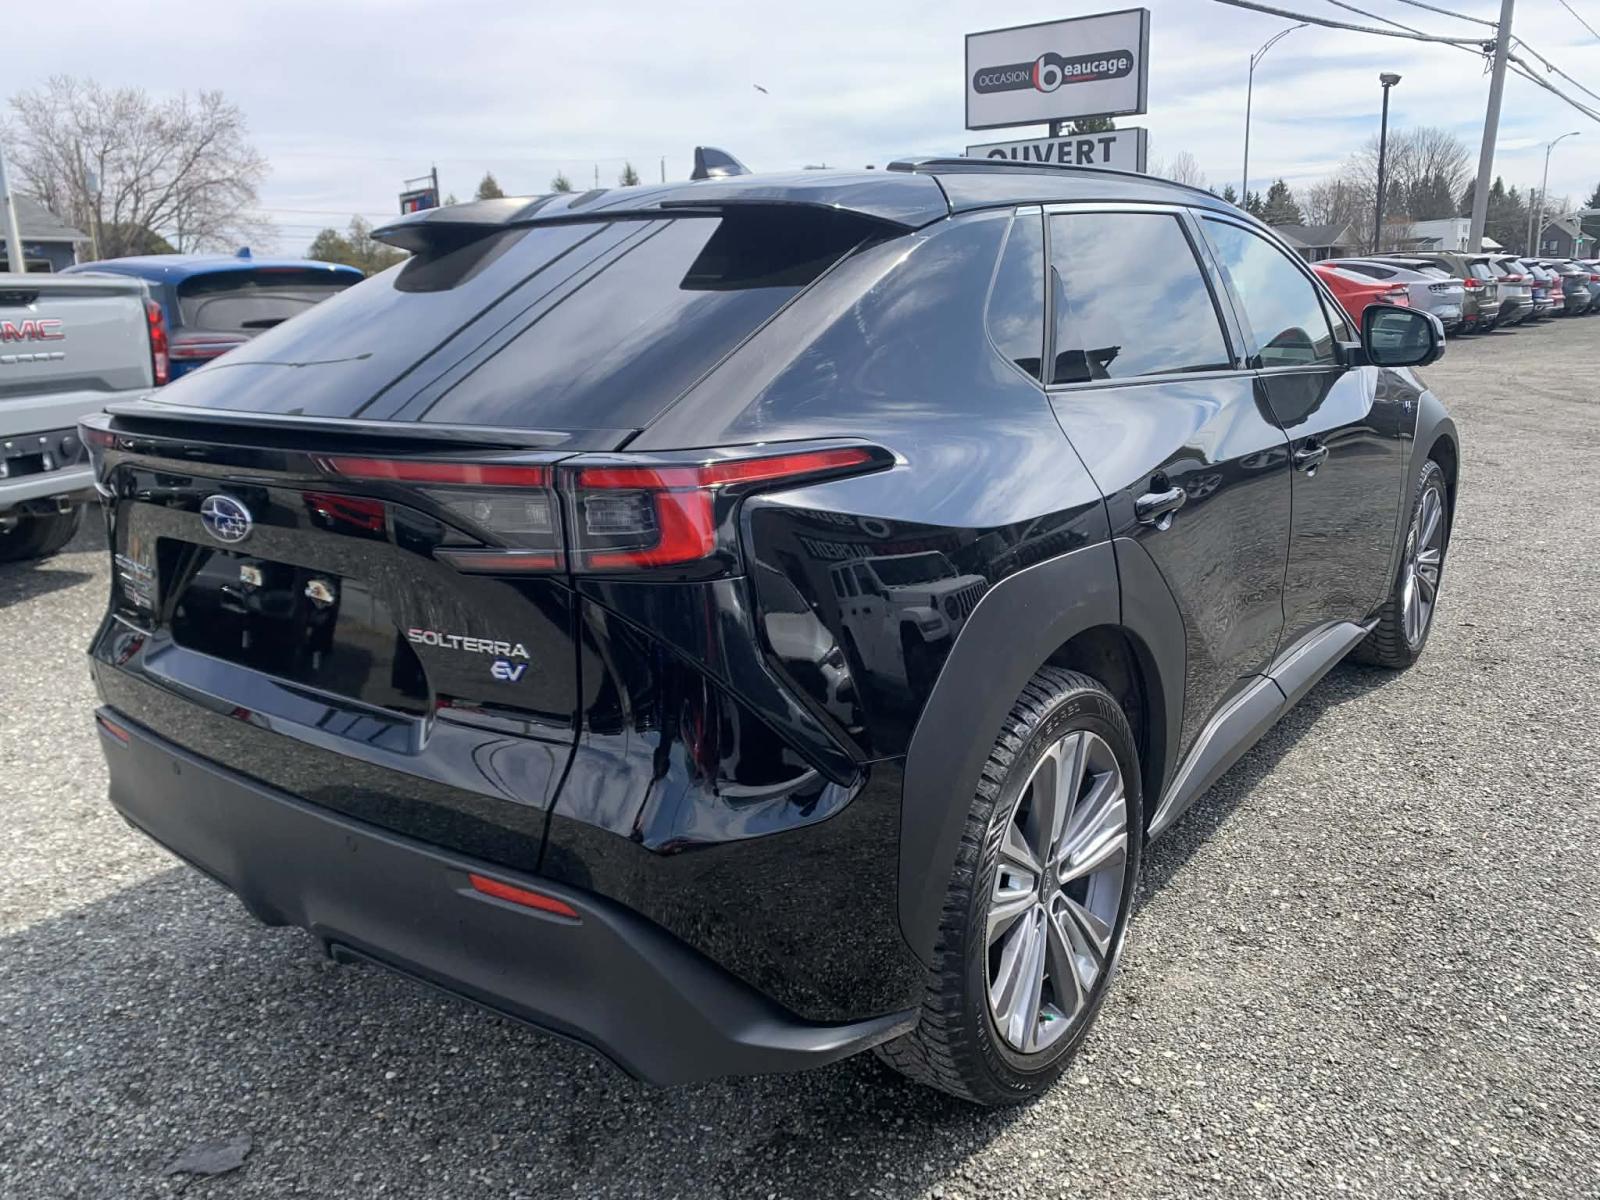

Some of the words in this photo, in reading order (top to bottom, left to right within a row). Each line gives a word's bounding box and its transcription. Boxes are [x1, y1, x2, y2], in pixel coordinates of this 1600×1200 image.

[978, 71, 1030, 87] OCCASION
[0, 319, 65, 342] MC
[407, 628, 530, 659] SOLTERRA
[490, 660, 528, 682] EV
